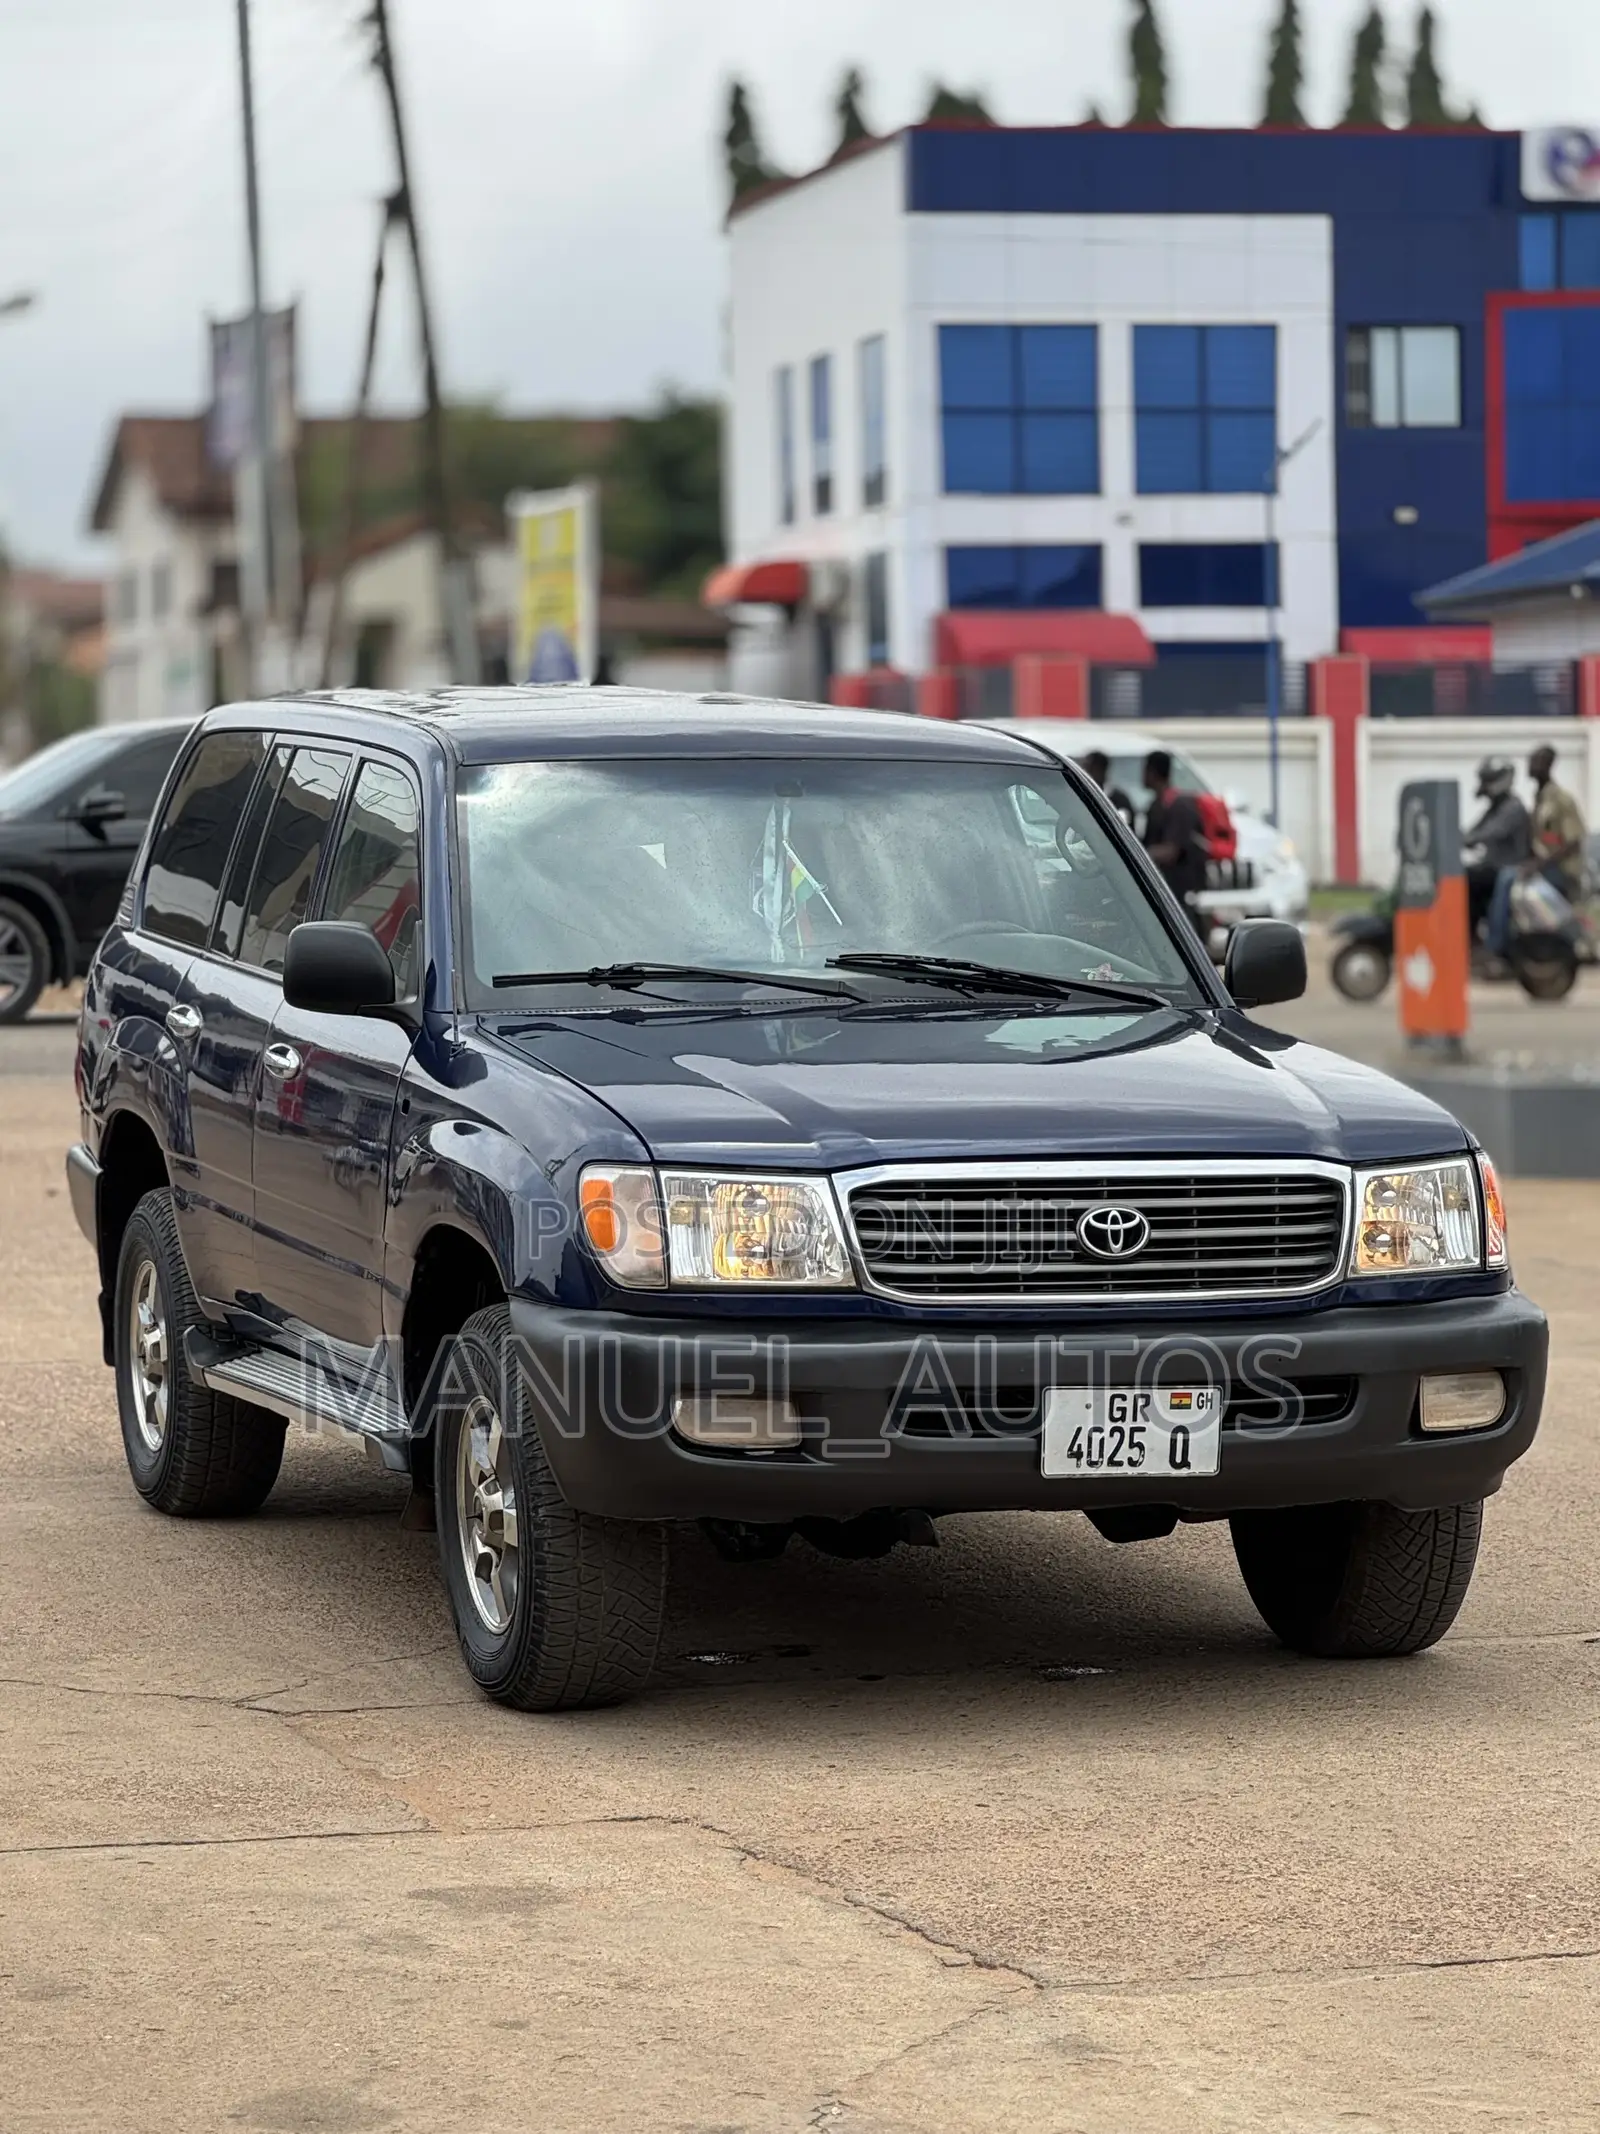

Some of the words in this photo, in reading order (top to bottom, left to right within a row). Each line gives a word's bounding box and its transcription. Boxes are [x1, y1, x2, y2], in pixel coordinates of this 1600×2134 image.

[1108, 1393, 1151, 1424] GR
[1196, 1392, 1214, 1411] GH
[1066, 1425, 1147, 1469] 4025
[1168, 1425, 1191, 1470] Q
